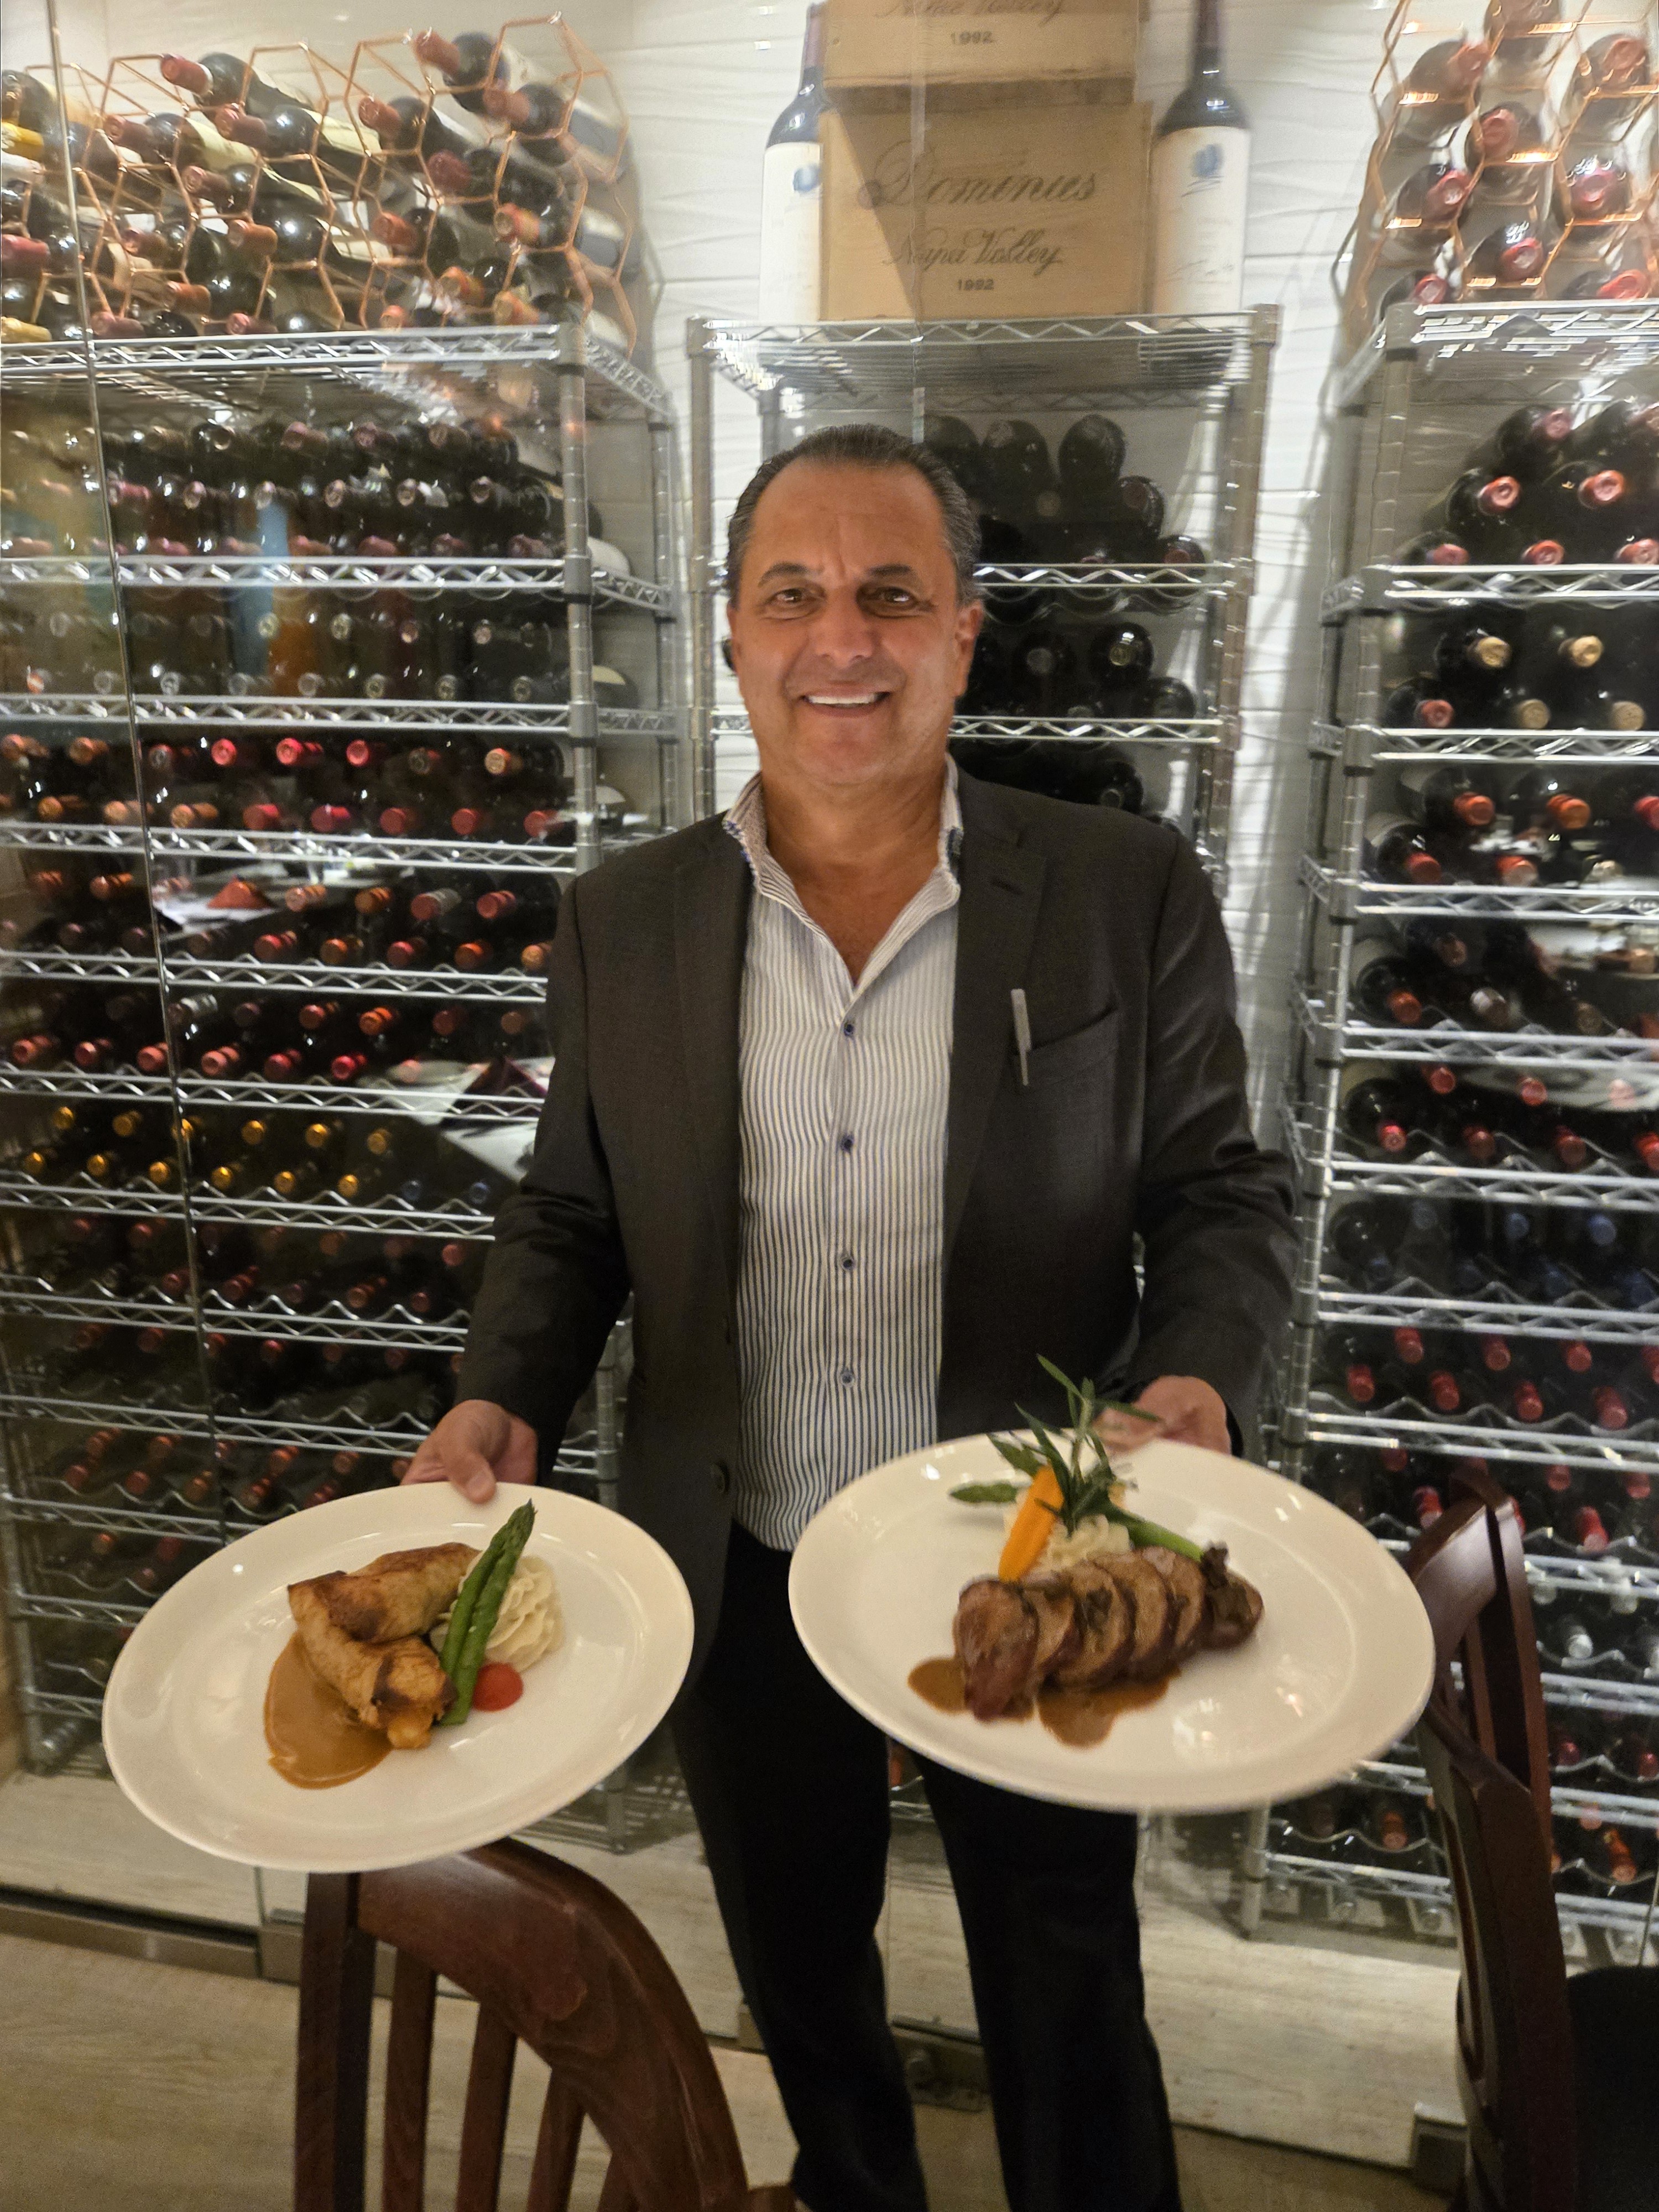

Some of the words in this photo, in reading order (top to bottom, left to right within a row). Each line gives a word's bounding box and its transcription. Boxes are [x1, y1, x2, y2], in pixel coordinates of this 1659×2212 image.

[872, 139, 1097, 205] Dominus
[885, 227, 968, 271] Napa
[963, 227, 1062, 277] Valley
